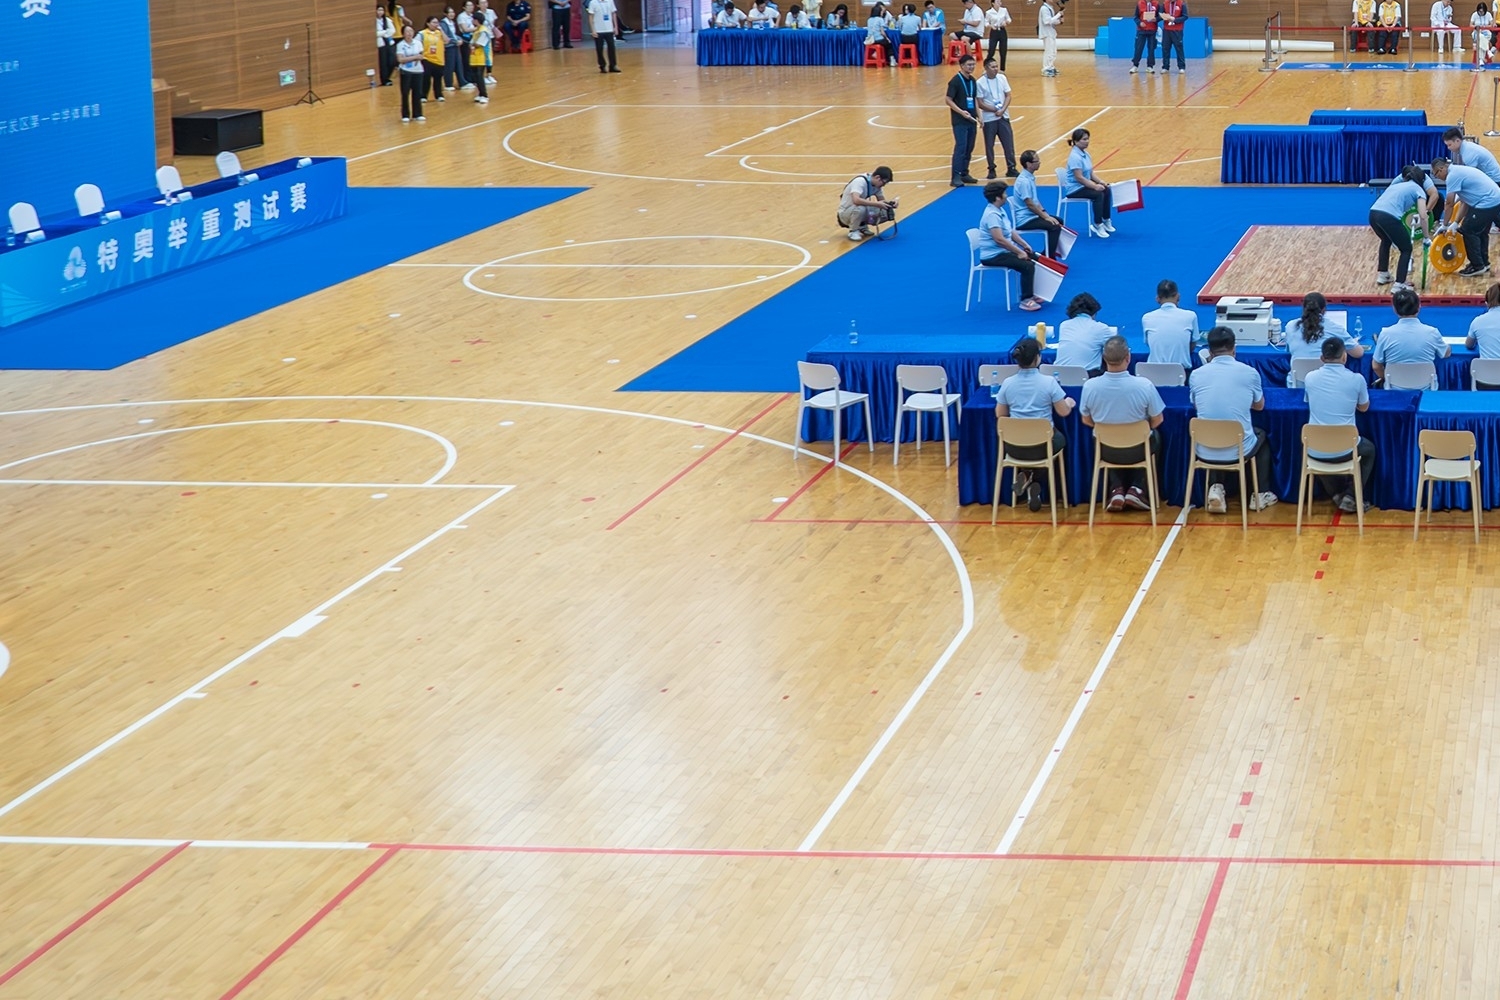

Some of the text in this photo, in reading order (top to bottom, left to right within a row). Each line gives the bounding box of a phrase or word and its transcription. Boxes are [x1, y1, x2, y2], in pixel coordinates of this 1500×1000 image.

[97, 182, 307, 273] 特奥举重测试赛
